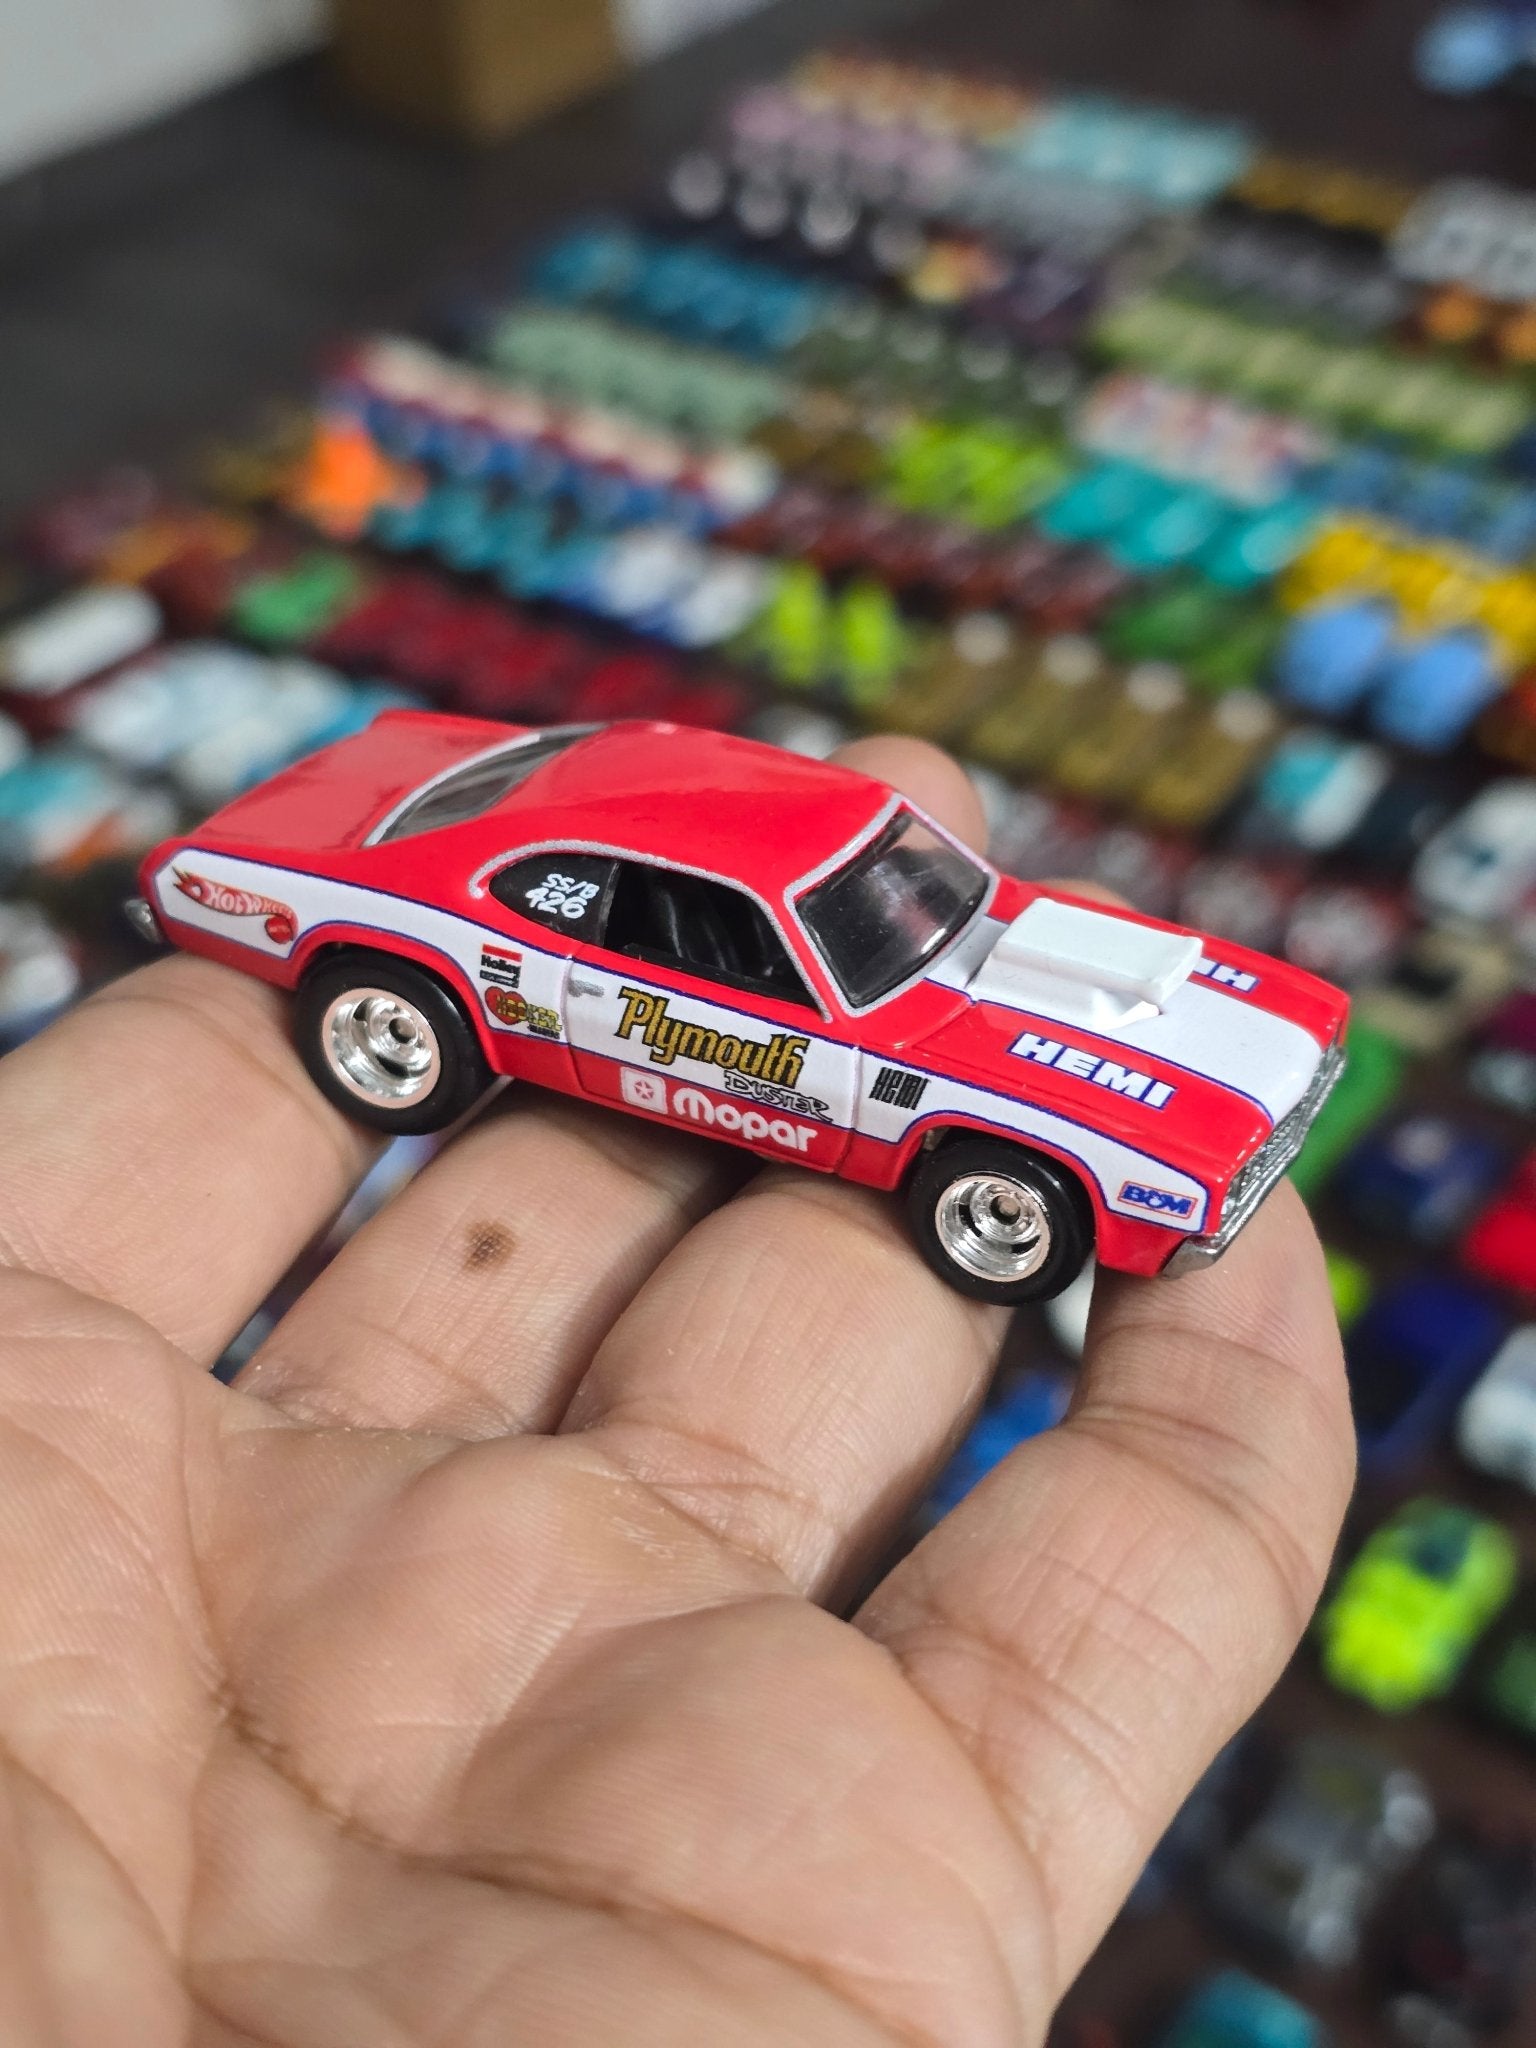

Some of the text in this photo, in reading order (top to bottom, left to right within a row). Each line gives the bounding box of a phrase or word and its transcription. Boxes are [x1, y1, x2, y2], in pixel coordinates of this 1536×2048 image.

[525, 887, 588, 920] 426
[541, 873, 600, 900] SS/B
[614, 986, 810, 1088] Plymouth
[724, 1070, 833, 1122] DUSTER
[1008, 1031, 1177, 1110] HEMI
